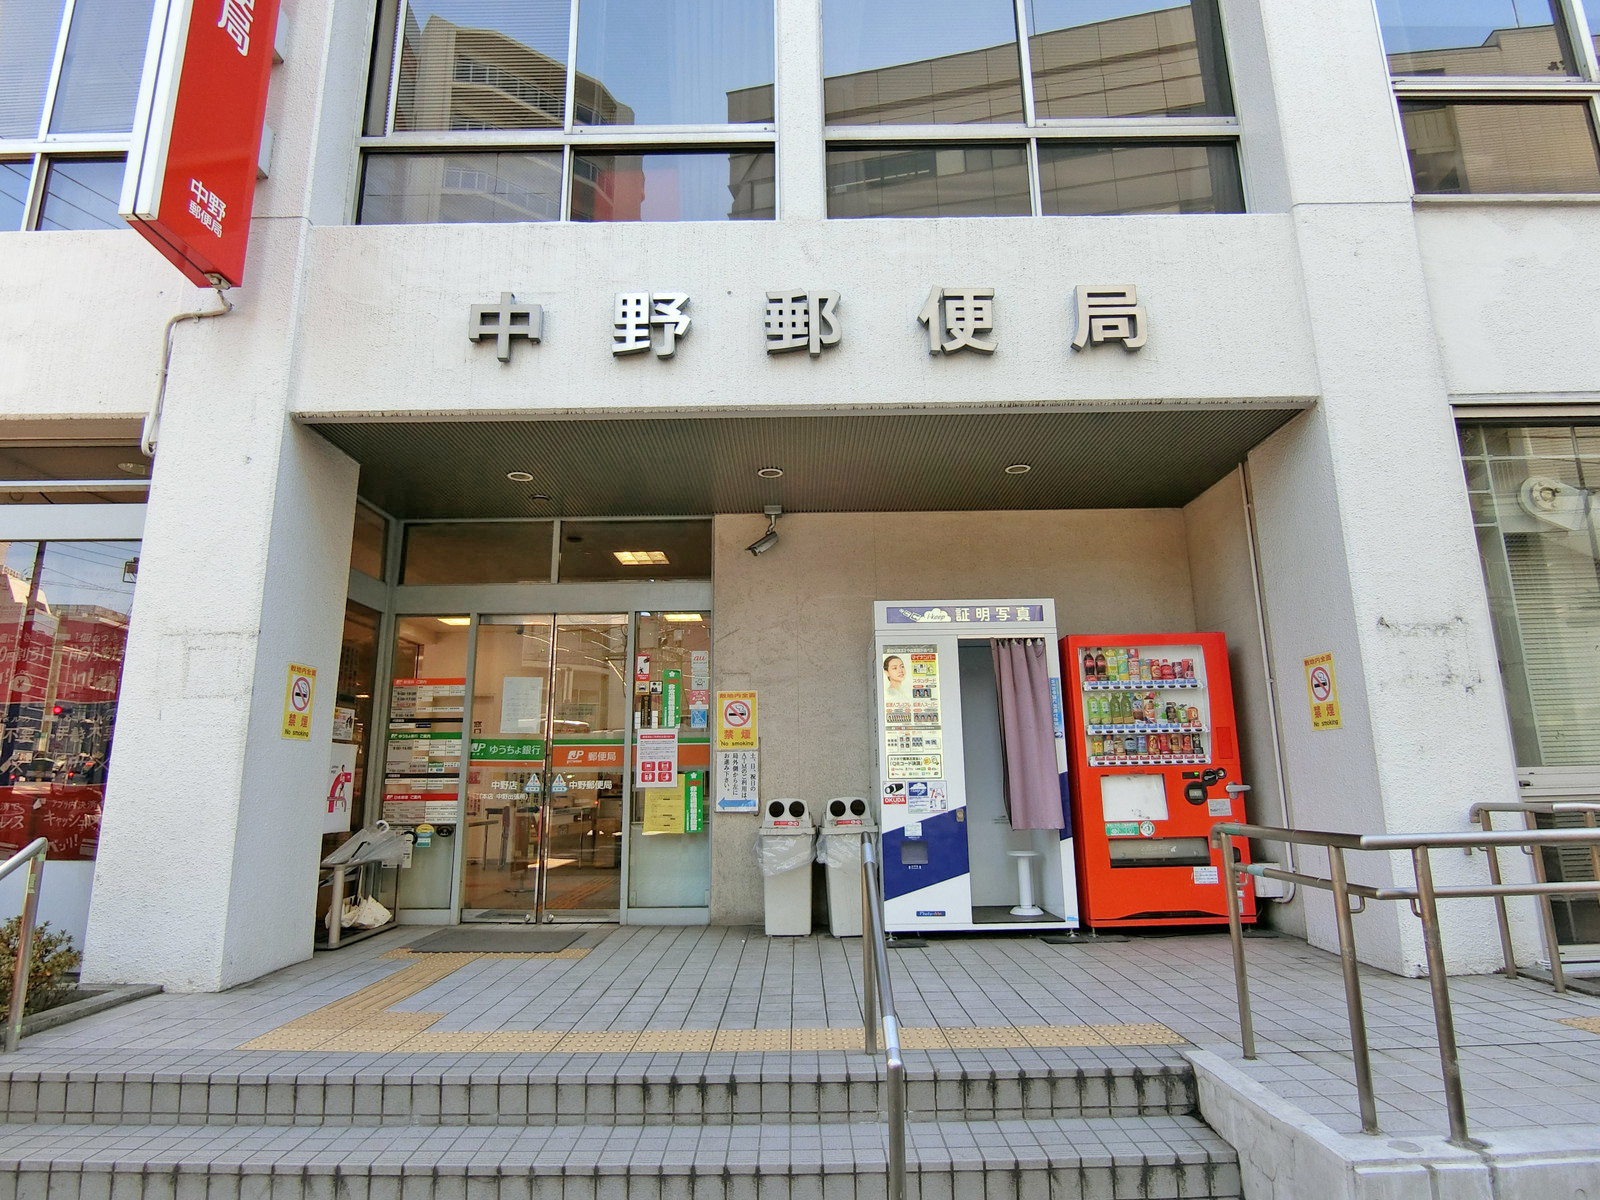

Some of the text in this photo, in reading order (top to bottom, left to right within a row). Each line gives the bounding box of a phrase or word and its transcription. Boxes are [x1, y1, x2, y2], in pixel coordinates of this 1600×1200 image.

[218, 0, 256, 57] 局
[189, 178, 227, 222] 中野
[188, 200, 223, 238] 郵便局
[468, 284, 1148, 364] 中野郵便局
[955, 607, 1031, 621] 証明写真
[1313, 703, 1336, 719] 禁煙
[288, 713, 309, 728] 禁煙
[1321, 719, 1339, 727] smoking
[723, 729, 751, 739] 禁煙
[489, 745, 541, 755] ゆうちょ銀行
[588, 752, 616, 761] 郵便局
[723, 753, 731, 791] お進み下さい。
[491, 780, 518, 790] 中野店
[569, 780, 612, 790] 中野郵便局
